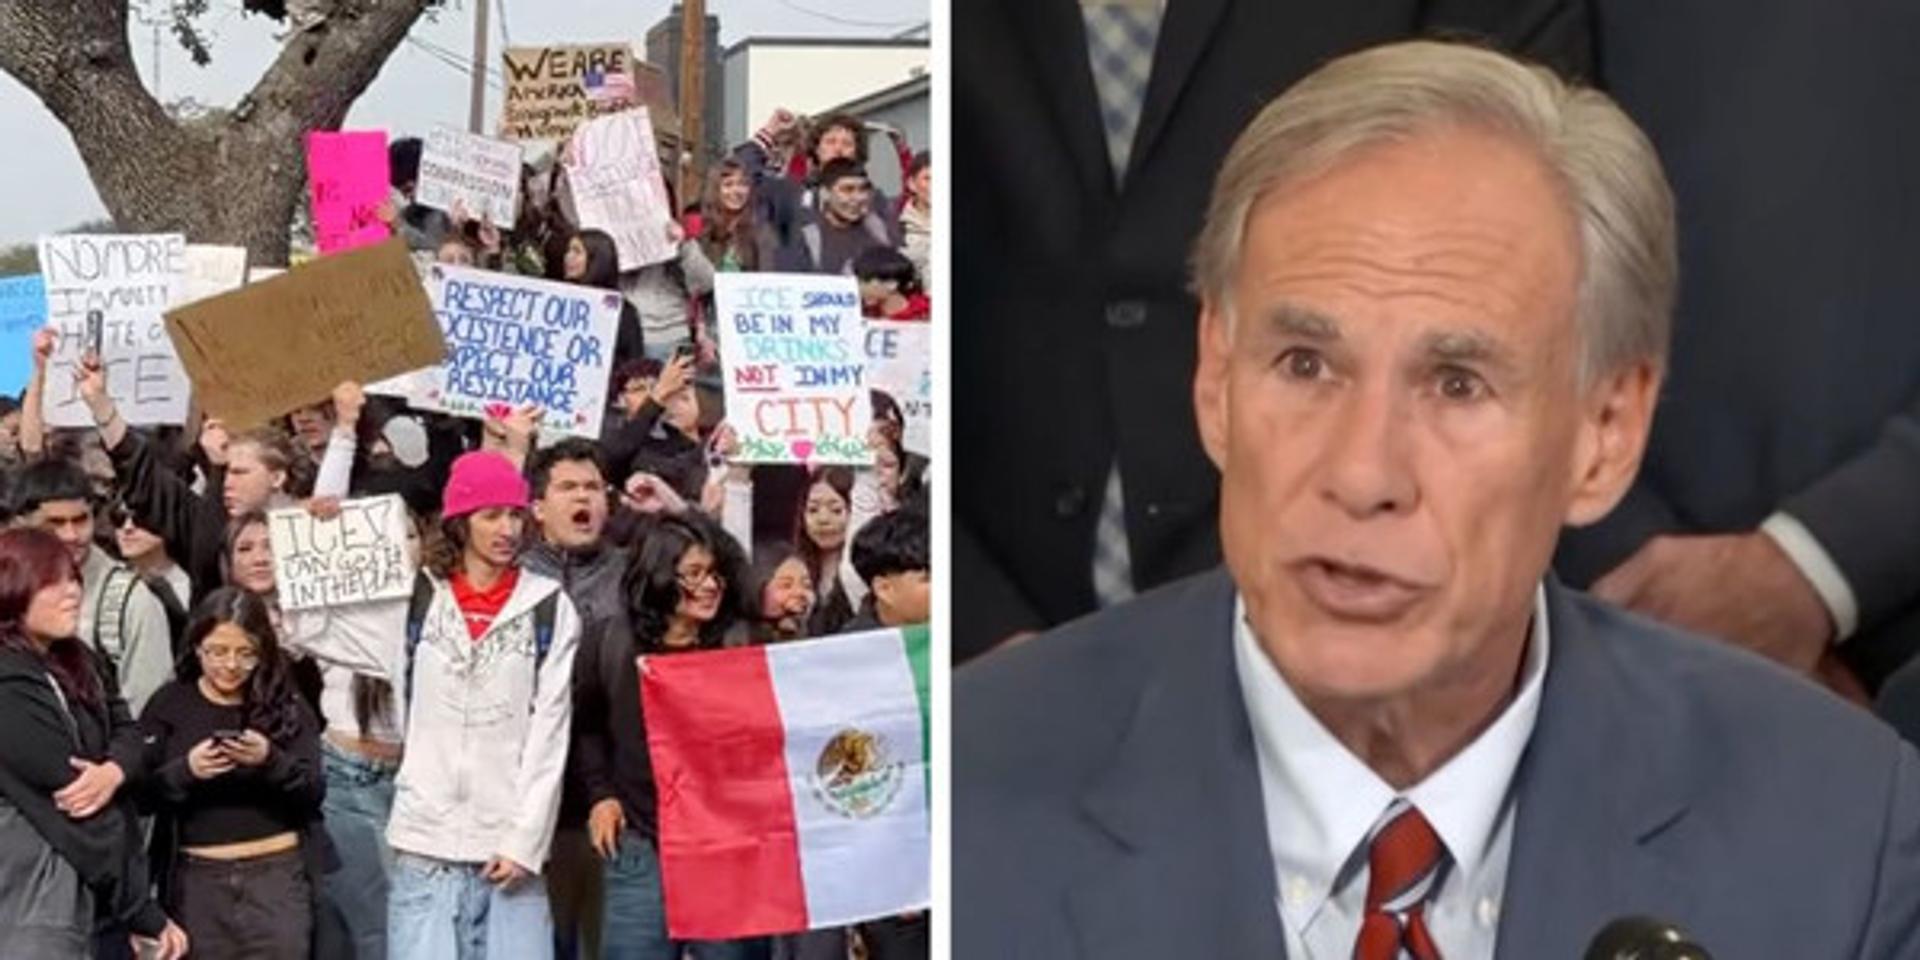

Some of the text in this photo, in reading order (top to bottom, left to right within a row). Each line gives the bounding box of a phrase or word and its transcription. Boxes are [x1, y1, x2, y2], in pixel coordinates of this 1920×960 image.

[502, 48, 567, 80] WE
[103, 237, 184, 277] MORE
[445, 281, 590, 330] RESPECT OUR
[736, 287, 791, 308] ICE
[735, 313, 840, 335] BE IN MY
[567, 334, 602, 366] OR
[531, 358, 577, 388] OUR
[735, 364, 864, 386] NOT IN MY
[446, 367, 578, 413] RESISTANCE
[755, 396, 856, 437] CITY
[290, 581, 317, 606] IN
